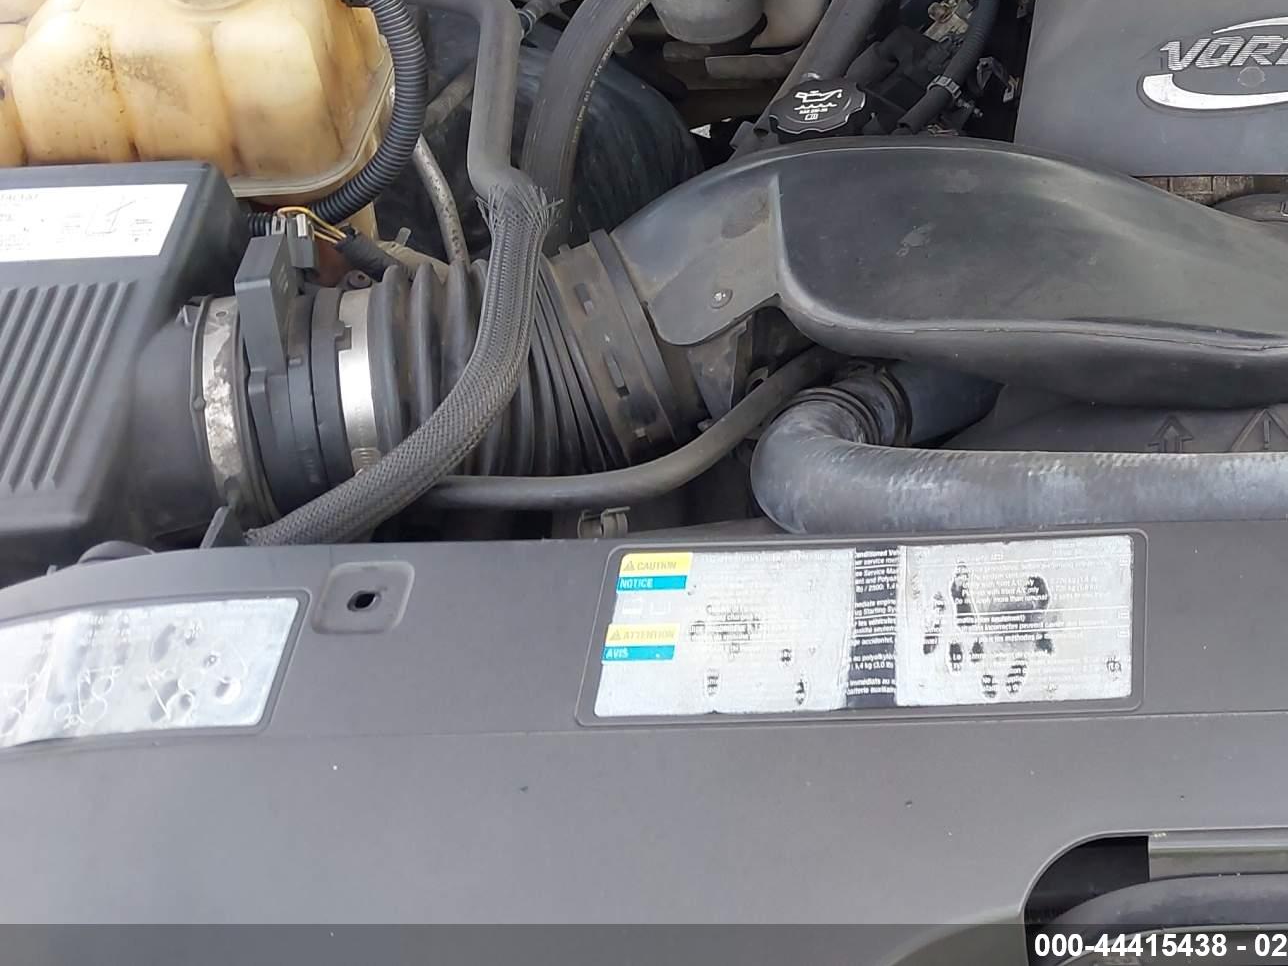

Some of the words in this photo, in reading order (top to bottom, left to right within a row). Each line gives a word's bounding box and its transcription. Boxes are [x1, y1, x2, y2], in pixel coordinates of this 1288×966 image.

[637, 561, 677, 571] CAUTION
[620, 577, 653, 589] NOTICE
[623, 631, 674, 640] ATTENTION
[606, 647, 629, 659] AVIS
